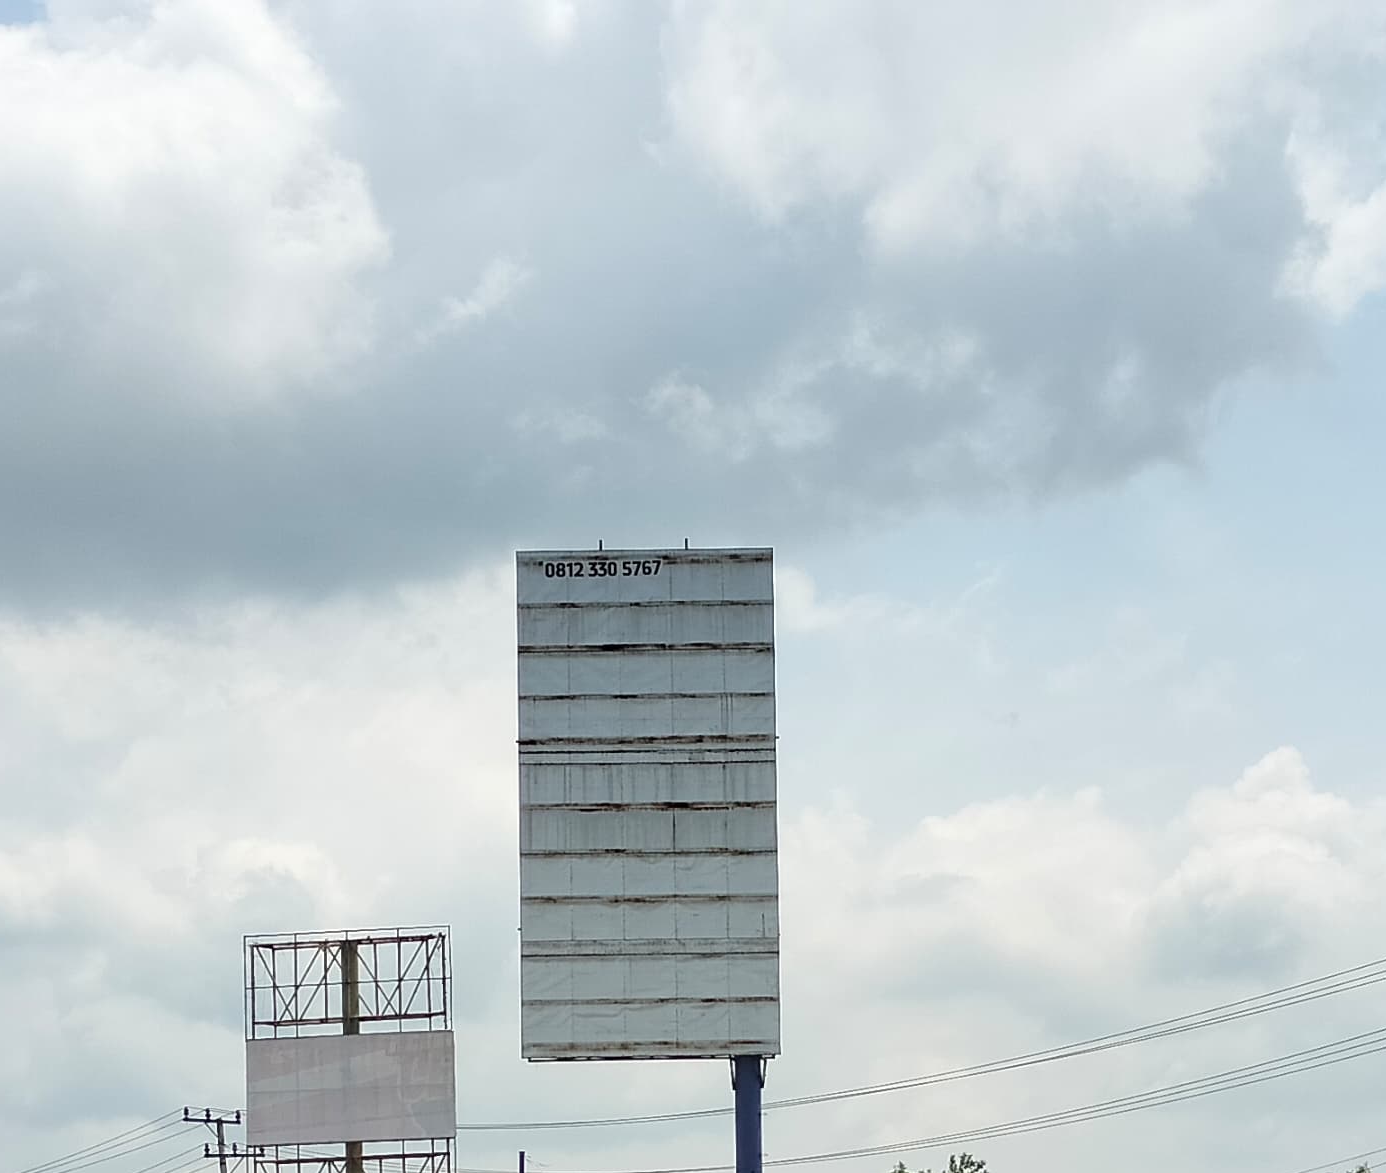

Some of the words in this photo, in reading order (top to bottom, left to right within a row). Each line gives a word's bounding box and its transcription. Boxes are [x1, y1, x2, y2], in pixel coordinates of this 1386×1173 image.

[544, 562, 584, 578] 0812
[588, 561, 617, 577] 330
[622, 559, 661, 577] 5767
